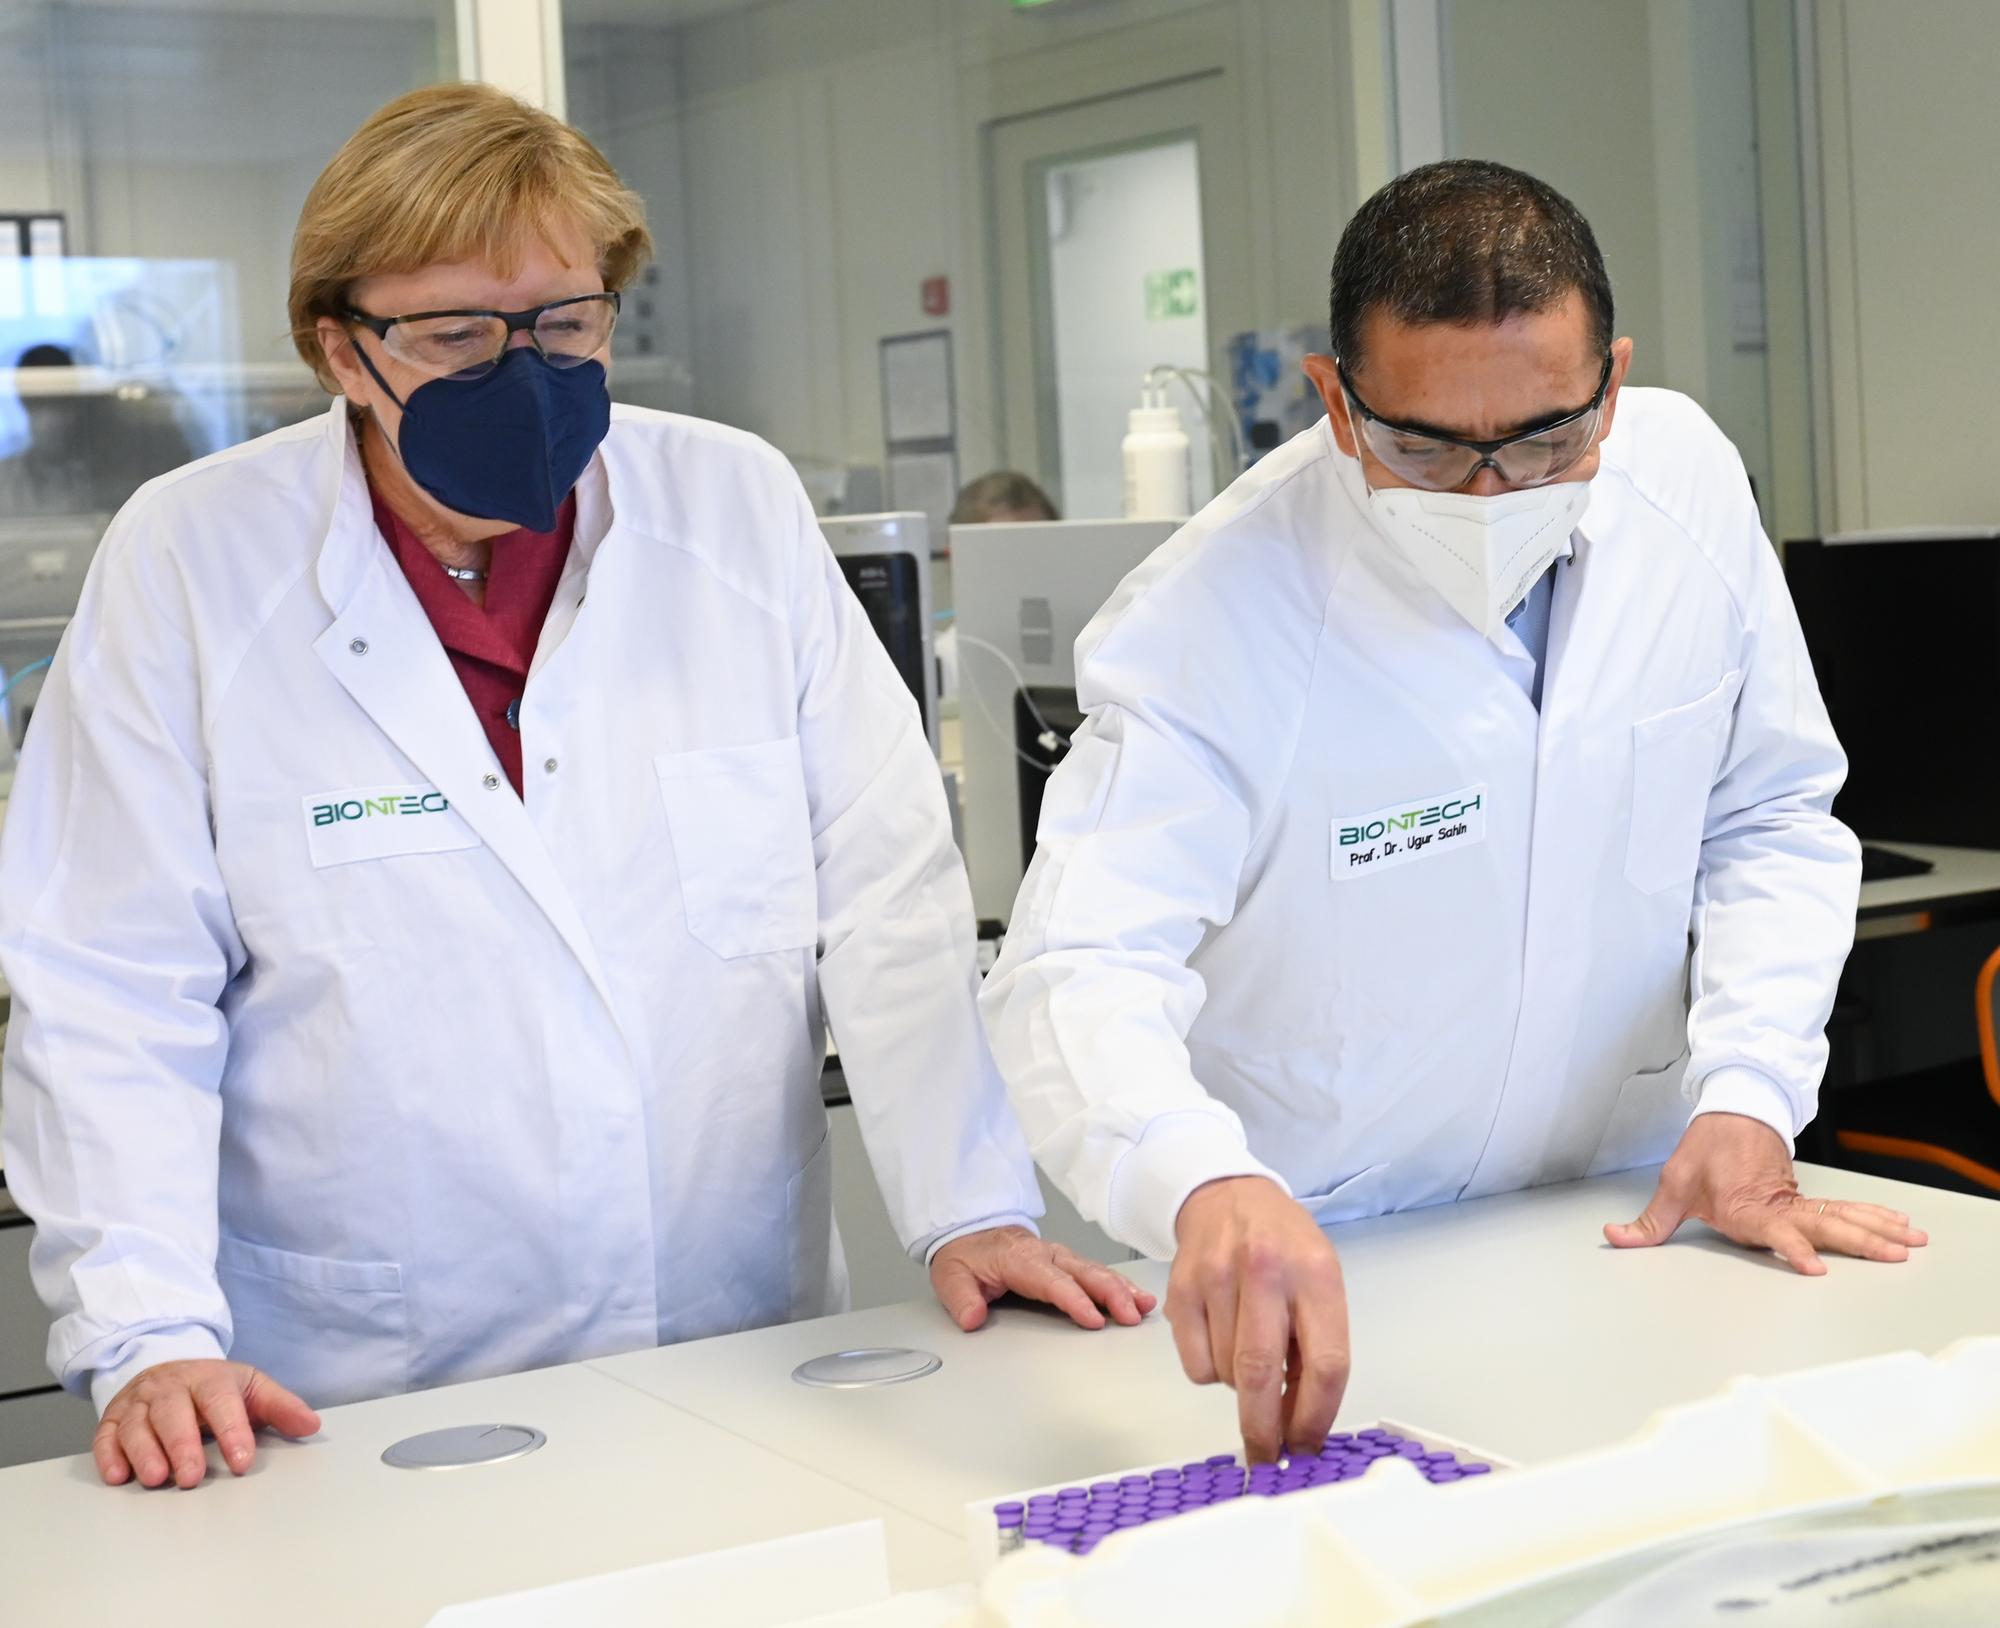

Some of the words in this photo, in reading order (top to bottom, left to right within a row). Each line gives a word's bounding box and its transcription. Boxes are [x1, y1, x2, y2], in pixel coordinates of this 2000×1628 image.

[1339, 794, 1481, 846] BIONTECH
[1384, 841, 1403, 857] Dr.
[1407, 833, 1433, 850] Ugur
[1437, 822, 1468, 841] Sahin
